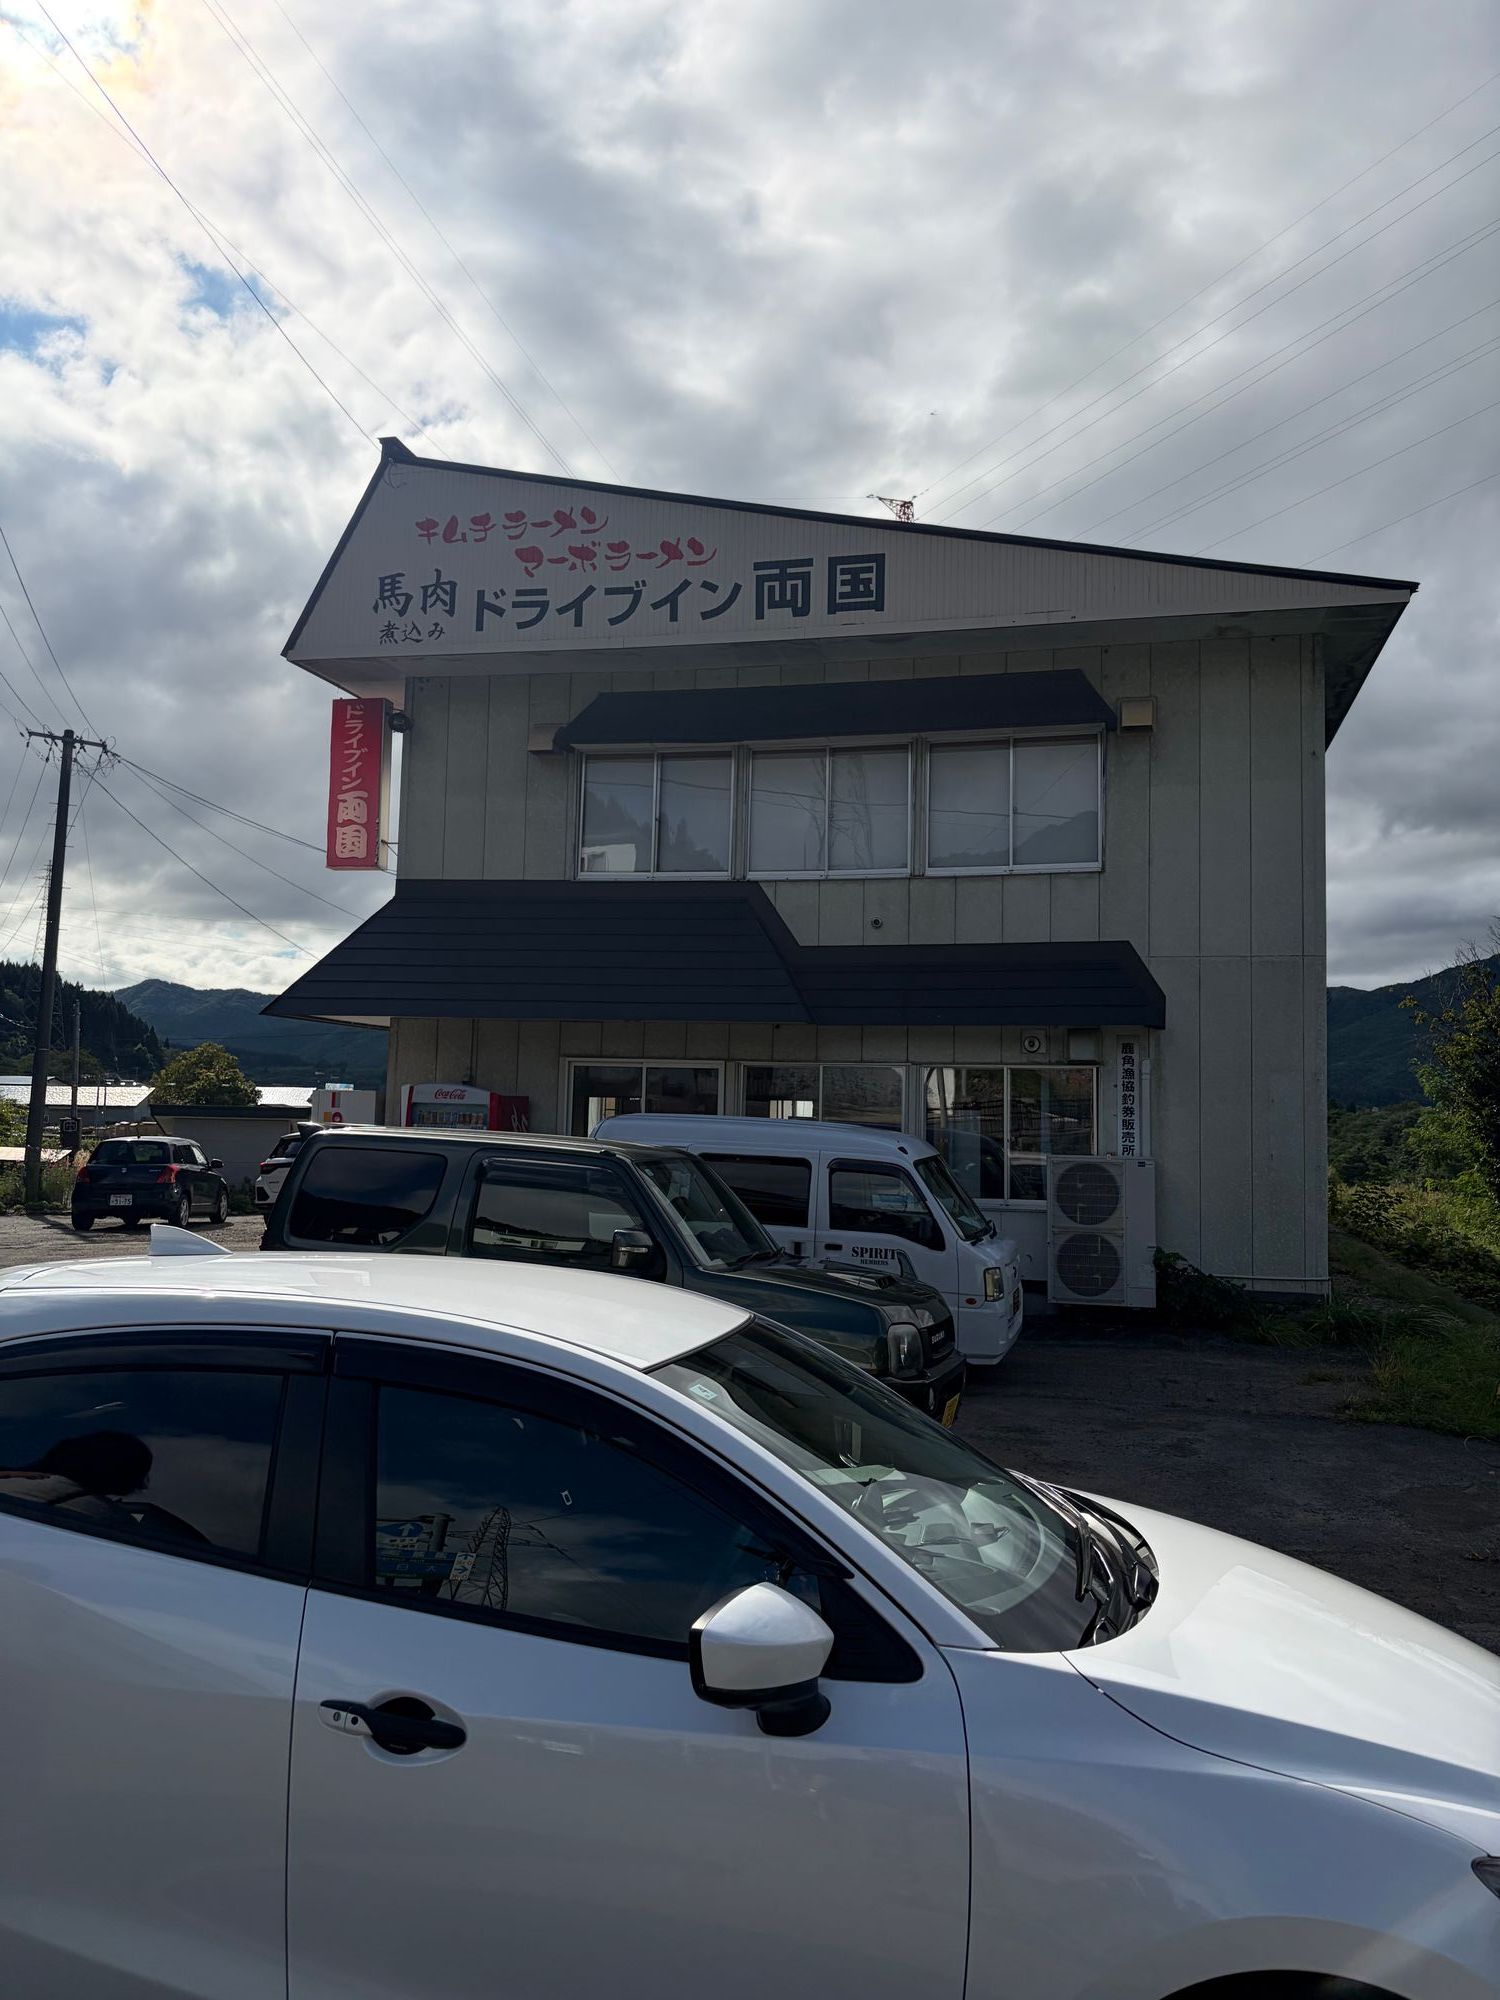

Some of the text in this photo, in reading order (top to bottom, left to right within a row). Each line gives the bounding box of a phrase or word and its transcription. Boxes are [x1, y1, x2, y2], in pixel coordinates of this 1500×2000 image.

[415, 505, 609, 545] キムチラーメン
[514, 536, 717, 577] マーボラーメン
[372, 567, 457, 618] 馬肉
[379, 620, 446, 645] 煮込み
[1121, 1042, 1135, 1156] 鹿角漁協釣券販売所
[851, 1246, 897, 1260] SPIRIT
